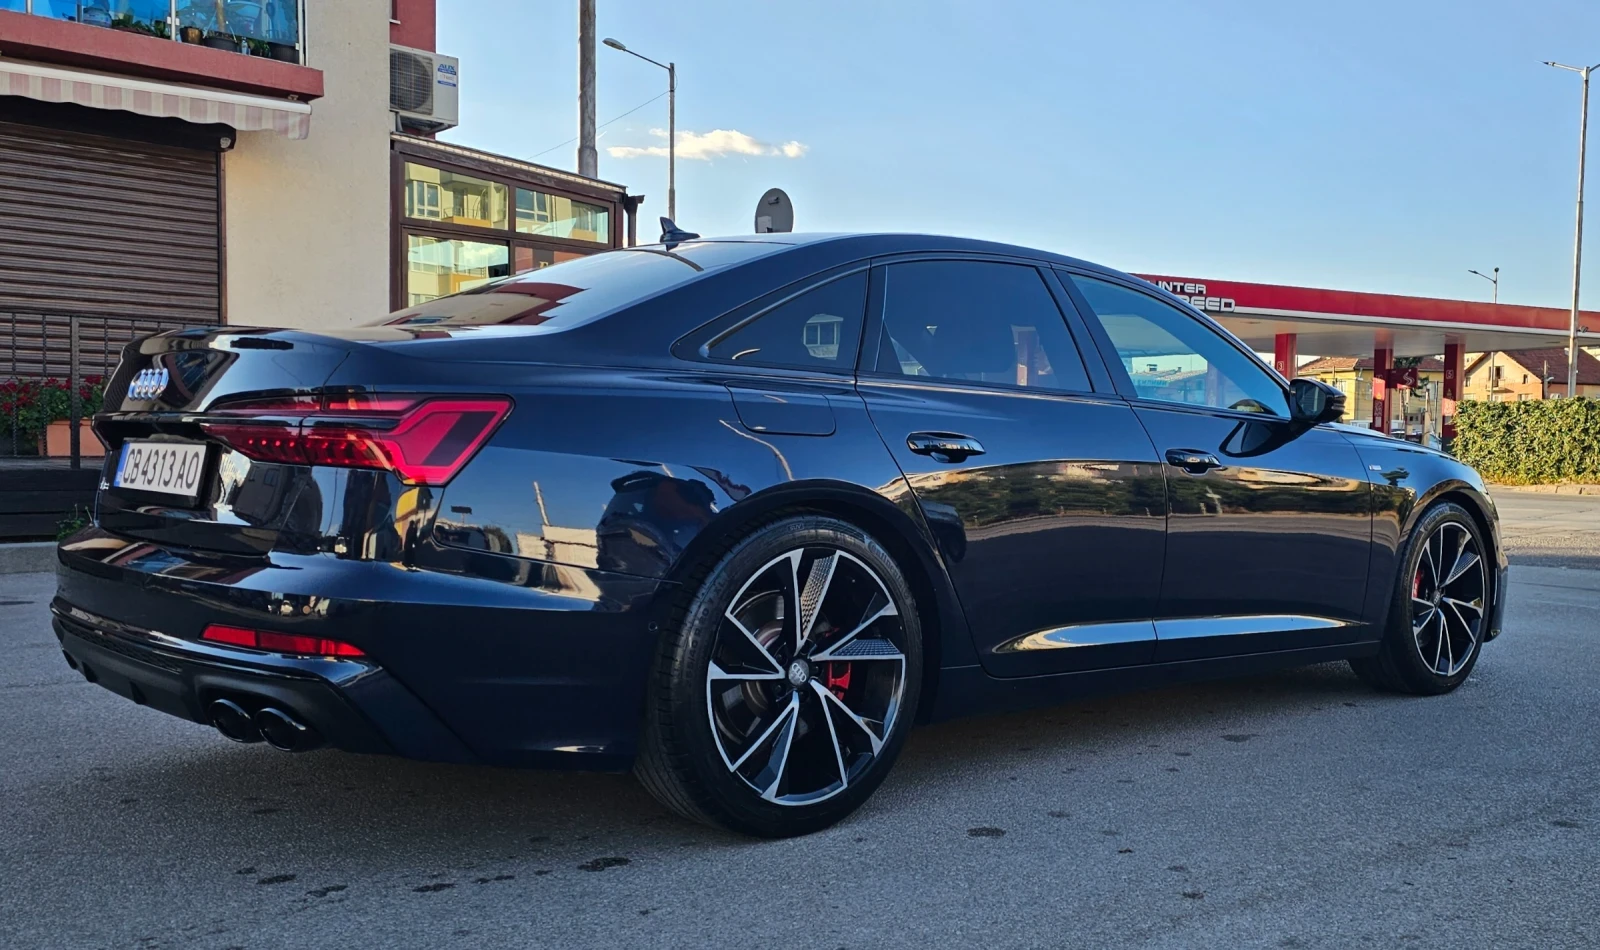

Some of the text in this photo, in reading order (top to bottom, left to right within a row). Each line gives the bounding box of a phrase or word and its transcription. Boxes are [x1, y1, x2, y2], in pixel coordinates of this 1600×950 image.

[123, 448, 199, 489] CB 4313 AO
